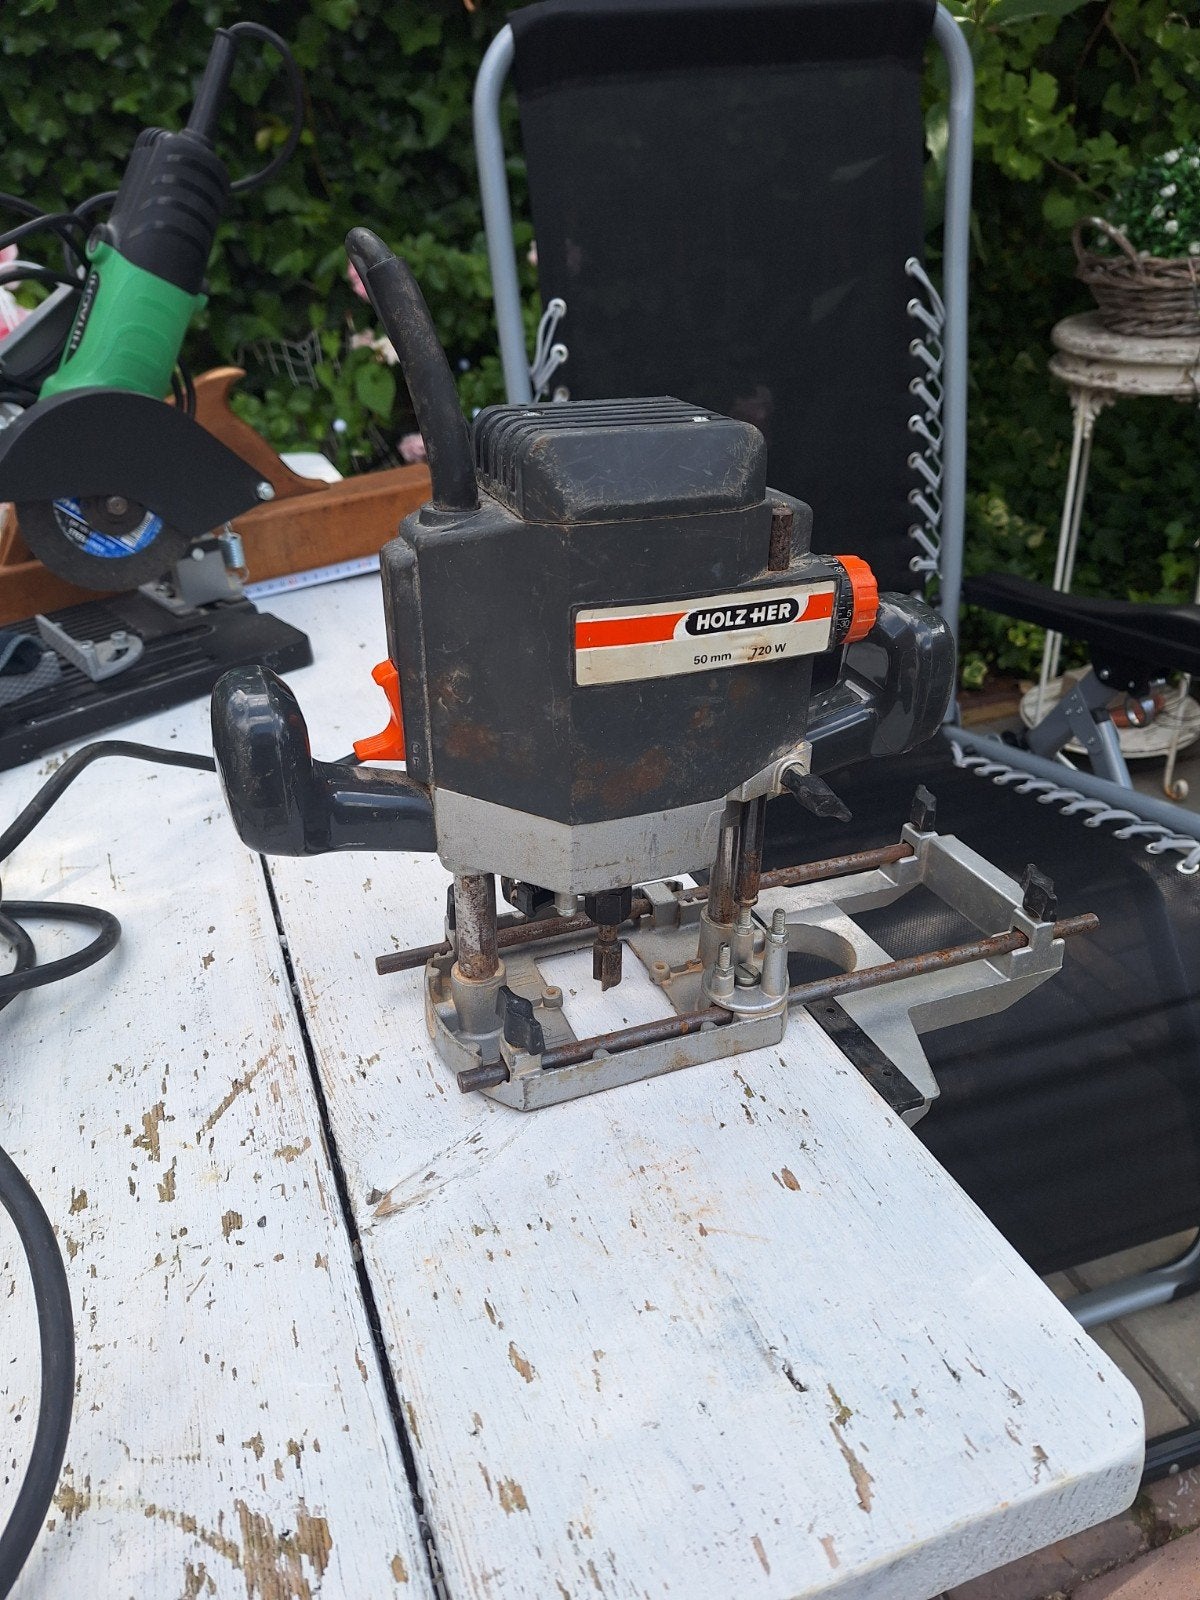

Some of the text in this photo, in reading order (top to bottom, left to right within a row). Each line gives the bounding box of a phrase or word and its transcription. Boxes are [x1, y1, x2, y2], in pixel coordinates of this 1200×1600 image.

[70, 274, 99, 350] HITACHI
[693, 642, 787, 665] 50 mm 720 W
